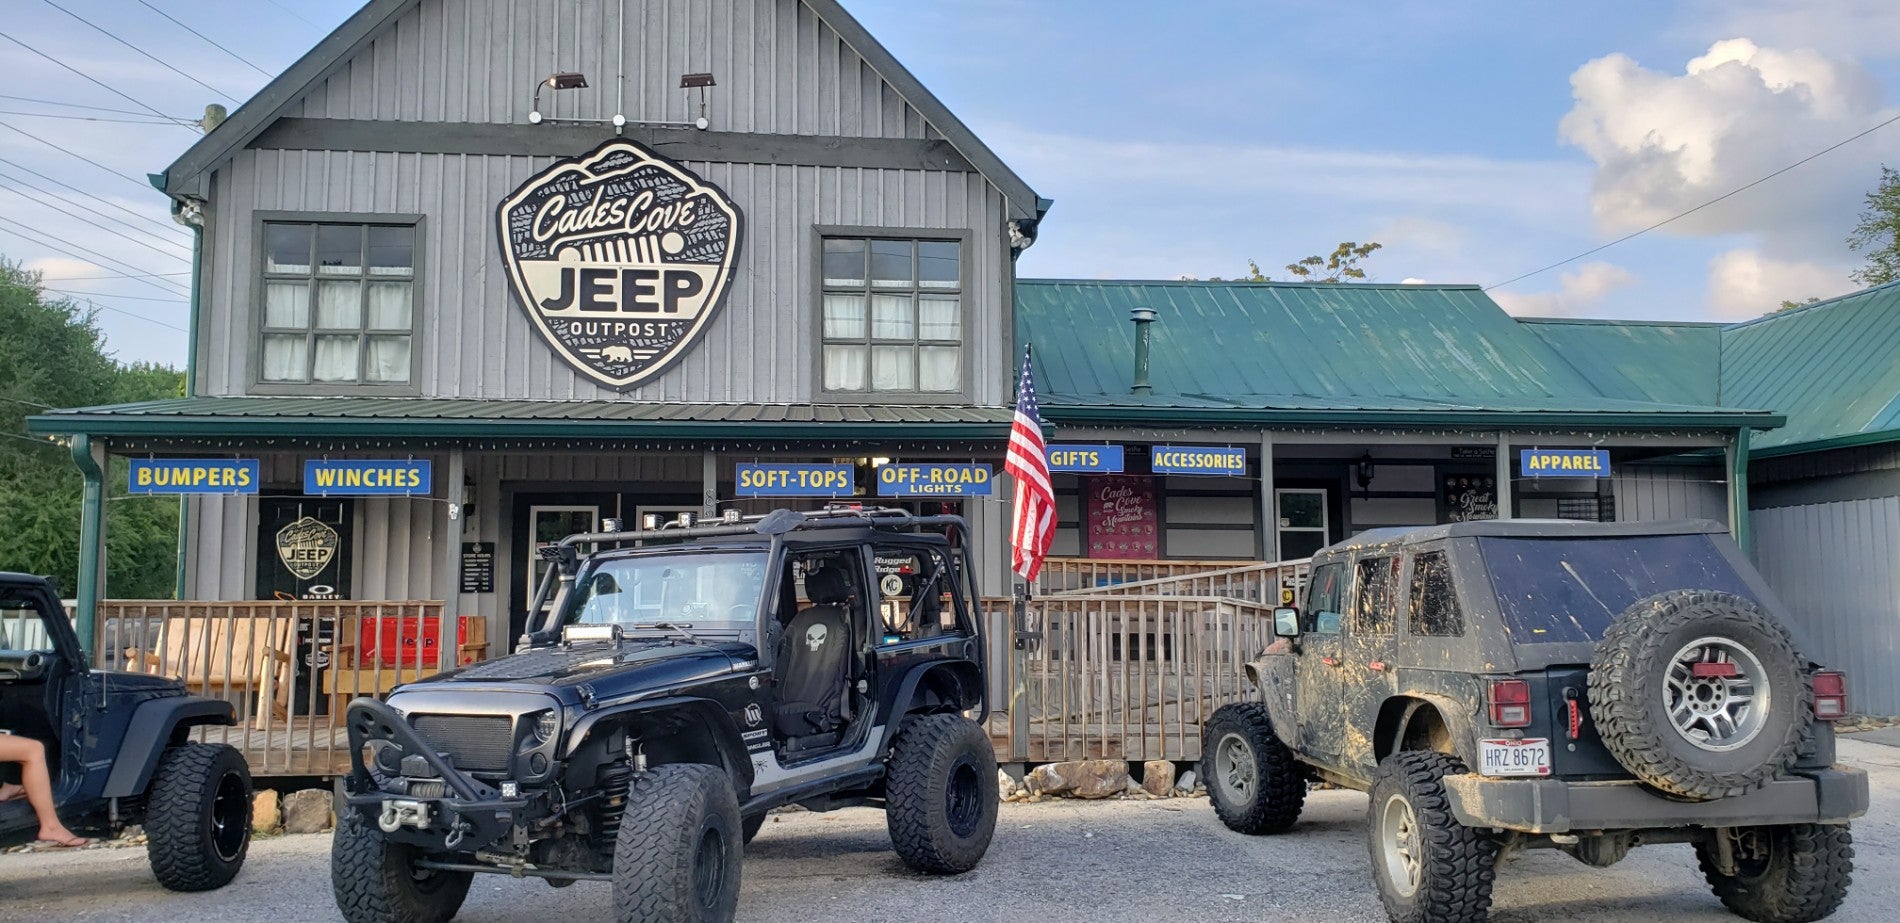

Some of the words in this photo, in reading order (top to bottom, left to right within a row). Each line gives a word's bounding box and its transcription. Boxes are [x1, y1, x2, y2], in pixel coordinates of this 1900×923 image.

[533, 185, 625, 242] Cades
[625, 191, 696, 232] Cove
[540, 267, 703, 313] JEEP
[570, 321, 669, 337] OUTPOST
[1050, 451, 1099, 466] GIFTS
[1154, 452, 1243, 469] ACCESSORIES
[1529, 455, 1602, 470] APPAREL
[137, 467, 251, 487] BUMPERS
[315, 468, 420, 487] WINCHES
[740, 469, 848, 488] SOFT-TOPS
[881, 467, 988, 484] OFF-ROAD
[910, 484, 962, 493] LIGHTS
[1101, 486, 1133, 500] Cades
[1115, 496, 1142, 512] Cove
[1460, 492, 1493, 509] Great
[287, 549, 328, 561] JEEP
[874, 556, 912, 565] Rugged
[885, 578, 898, 592] KC
[1486, 749, 1510, 766] HRZ
[1513, 748, 1545, 766] 8672
